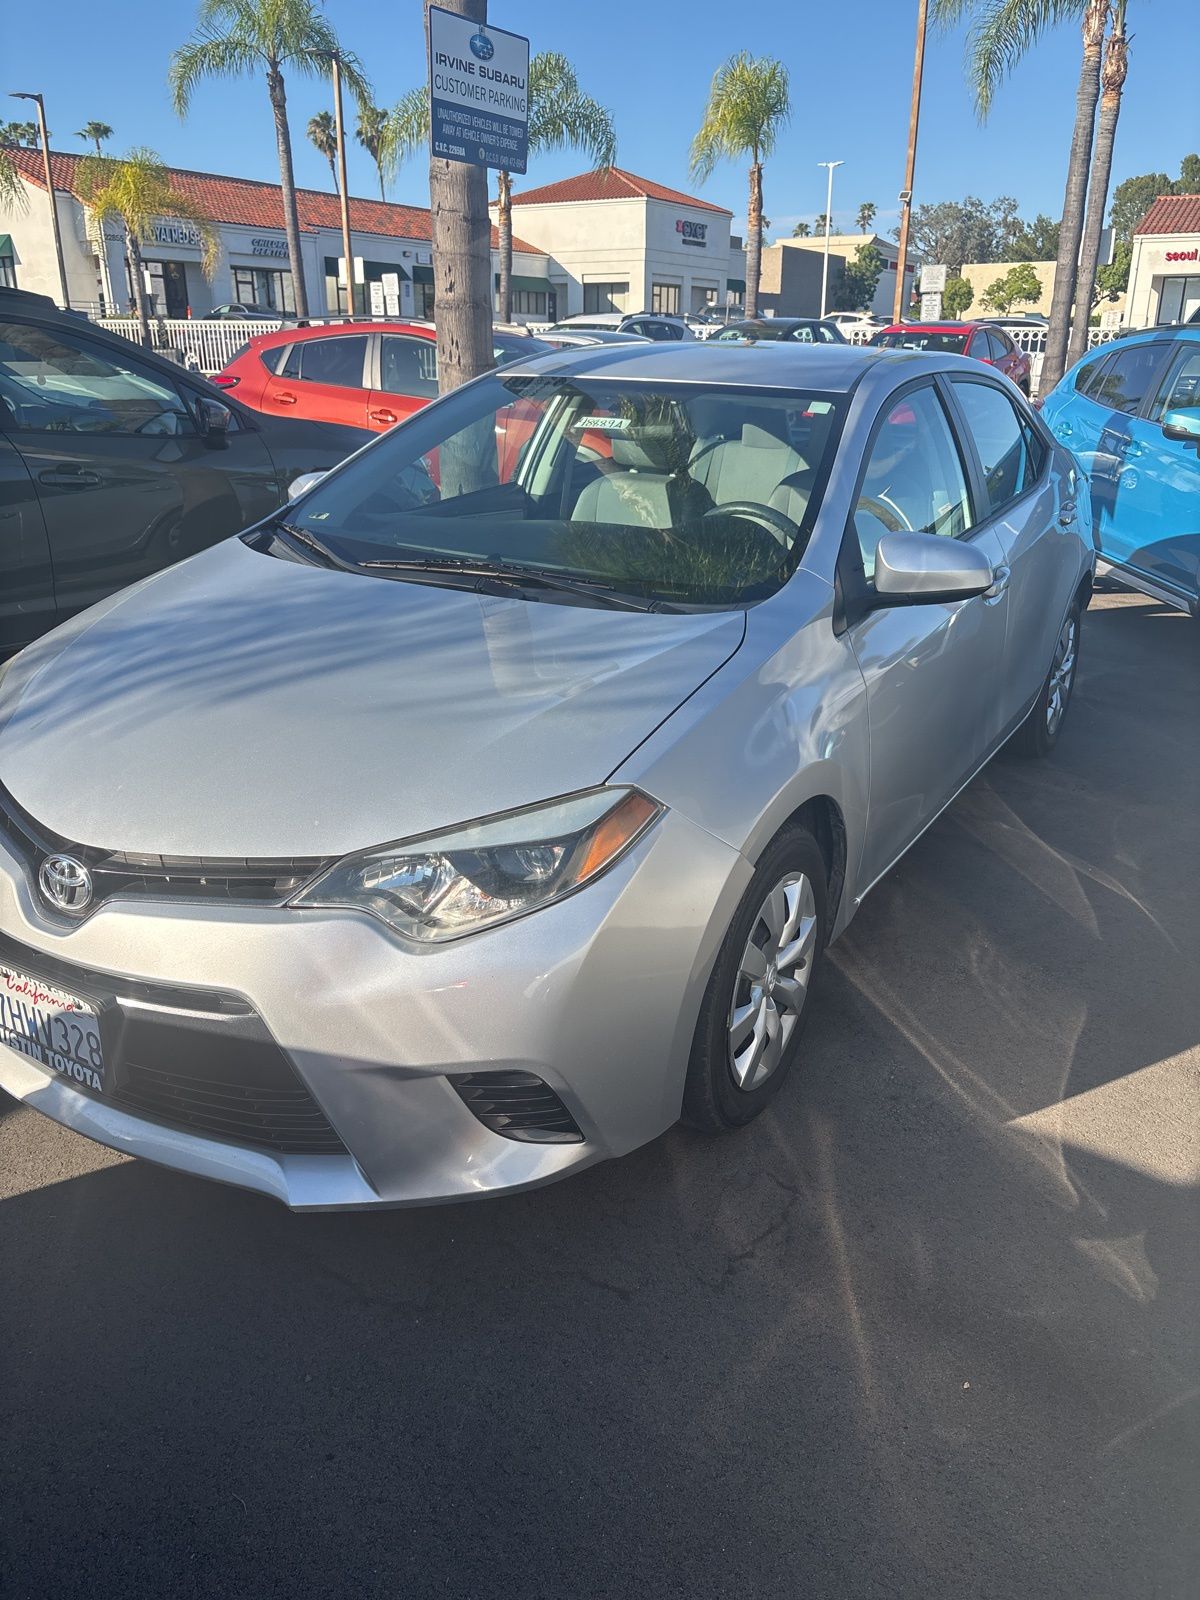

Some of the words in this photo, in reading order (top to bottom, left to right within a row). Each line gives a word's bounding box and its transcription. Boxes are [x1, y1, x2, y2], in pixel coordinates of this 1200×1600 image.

[435, 51, 475, 75] IRVINE
[478, 65, 525, 90] SUBARU
[434, 73, 487, 103] CUSTOMER
[488, 89, 526, 113] PARKING
[437, 107, 471, 126] UNAUTHORIZED
[472, 116, 492, 131] VEHICLES
[492, 120, 502, 134] WILL
[502, 123, 509, 135] BE
[509, 125, 524, 139] TOWED
[442, 123, 456, 136] AWAY
[455, 126, 462, 138] AT
[462, 128, 480, 142] VEHICLE
[1165, 248, 1199, 262] seoul
[6, 975, 80, 1016] California
[45, 1049, 103, 1092] TOYOTA
